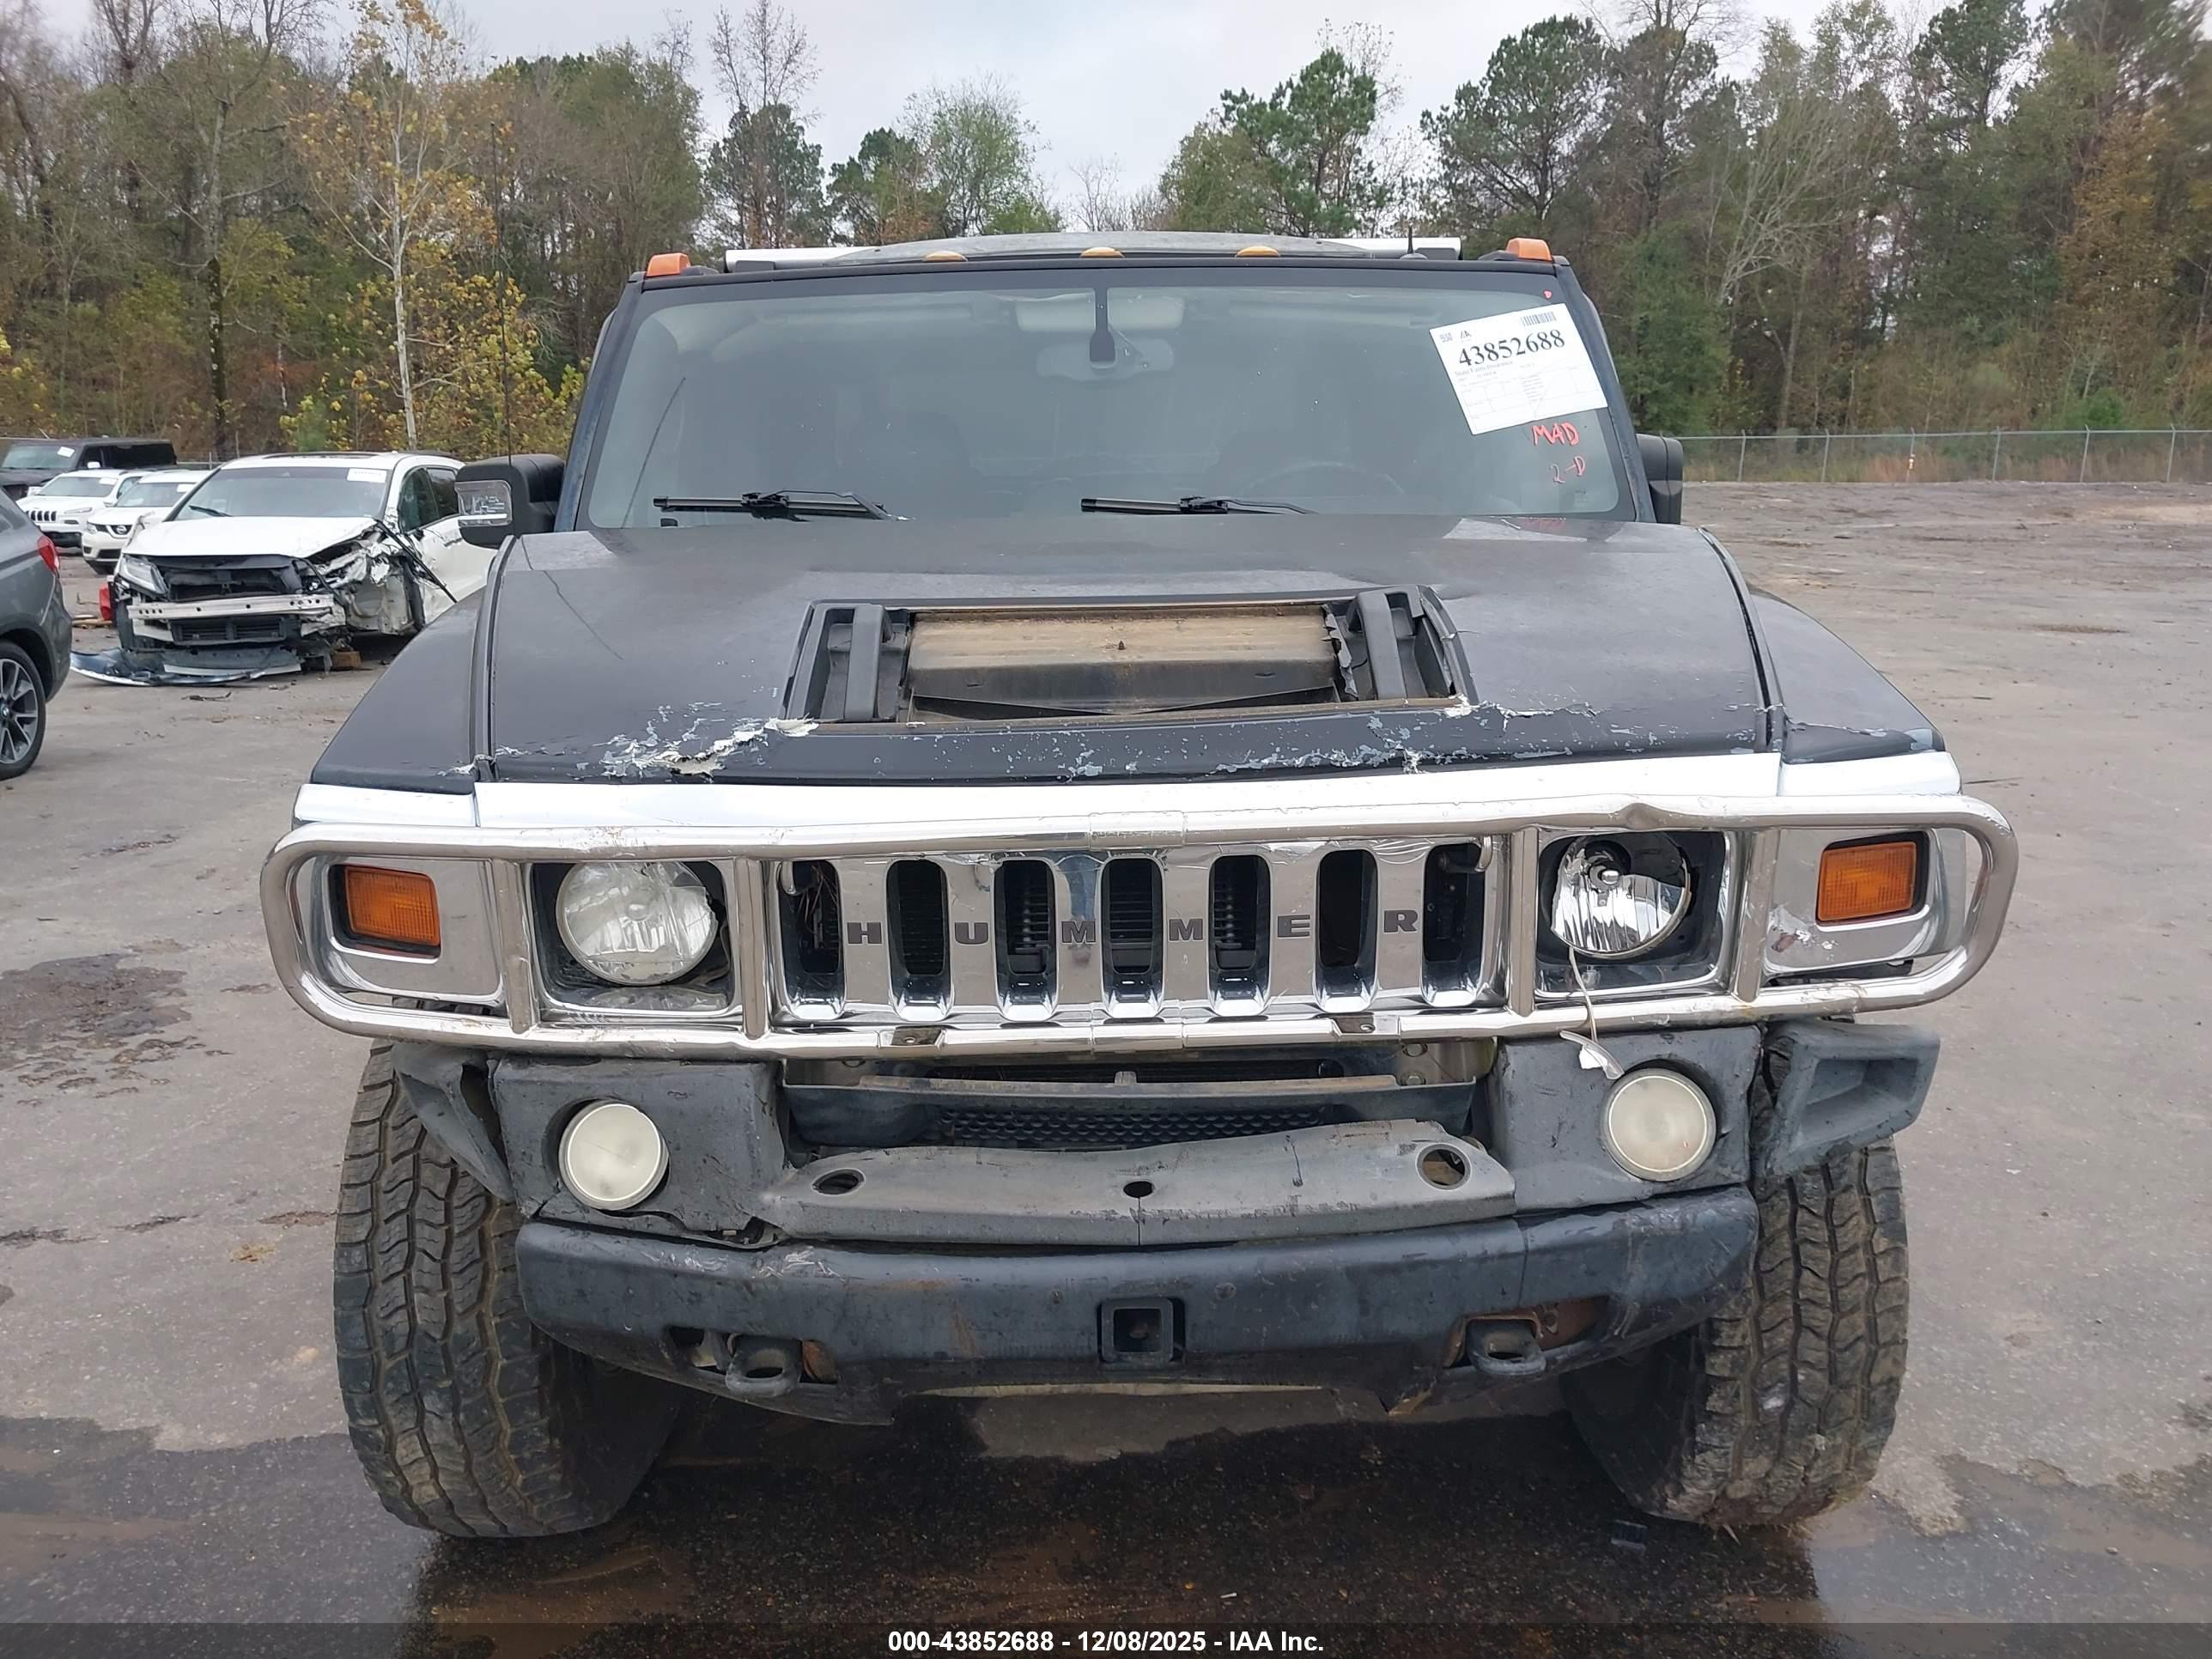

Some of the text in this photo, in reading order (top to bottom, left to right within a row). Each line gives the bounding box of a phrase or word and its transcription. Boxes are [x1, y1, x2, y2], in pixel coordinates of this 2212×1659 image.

[1459, 329, 1565, 366] 43852688
[1532, 422, 1579, 446] MAD
[847, 908, 1418, 945] HUMMER
